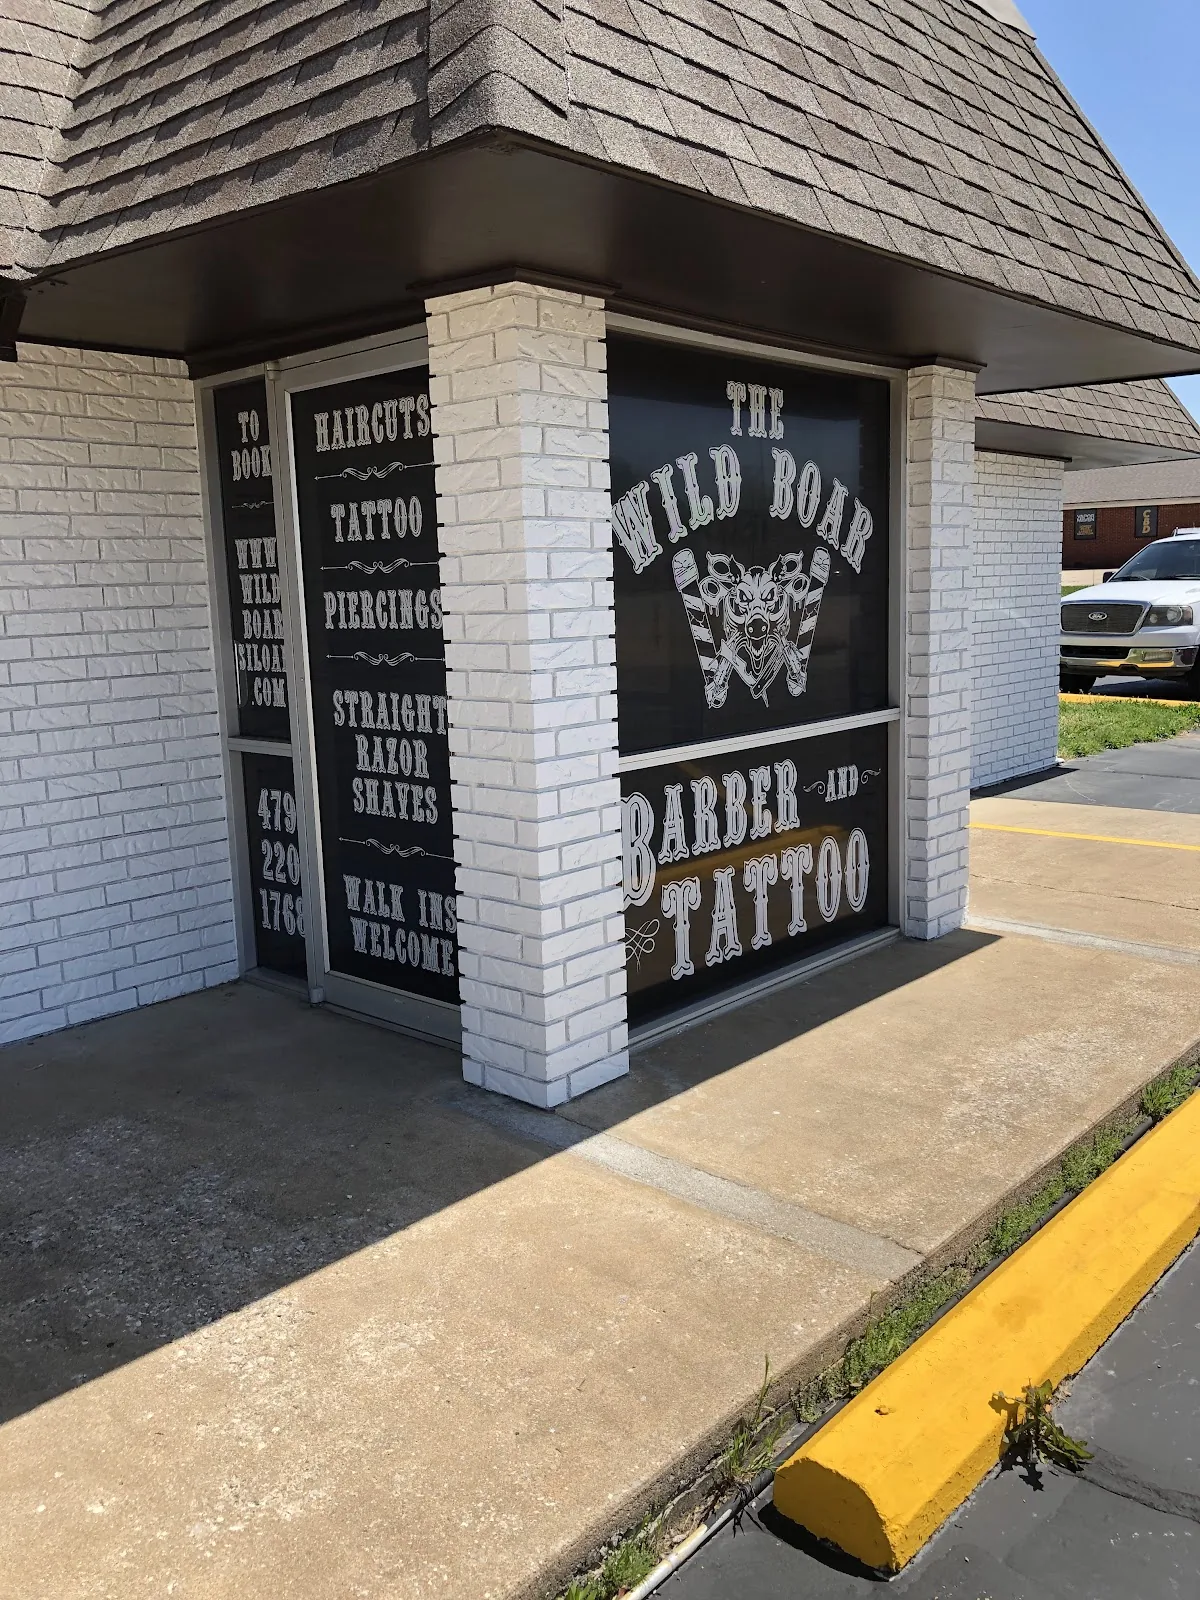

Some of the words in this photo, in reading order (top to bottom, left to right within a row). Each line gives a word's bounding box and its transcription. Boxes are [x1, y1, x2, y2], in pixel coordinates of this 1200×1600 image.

[238, 409, 259, 443] TO
[314, 394, 430, 452] HAIRCUTS
[726, 380, 784, 439] THE
[231, 445, 272, 481] BOOK
[330, 496, 423, 542] TATTOO
[611, 444, 742, 574] WILD
[769, 447, 873, 574] BOAR
[235, 537, 277, 568] WWW
[239, 573, 280, 604] WILD
[323, 589, 443, 630] PIERCINGS
[242, 609, 284, 639] BOAR
[252, 677, 286, 707] .COM
[332, 689, 446, 735] STRAIGHT
[355, 734, 430, 778] RAZOR
[257, 788, 297, 834] 479
[353, 777, 438, 825] SHAVES
[620, 758, 800, 912] BARBER
[825, 764, 859, 802] AND
[261, 838, 300, 885] 220
[343, 874, 405, 922] WALK
[417, 889, 457, 934] INS
[661, 827, 870, 980] TATTOO
[350, 917, 454, 976] WELCOME
